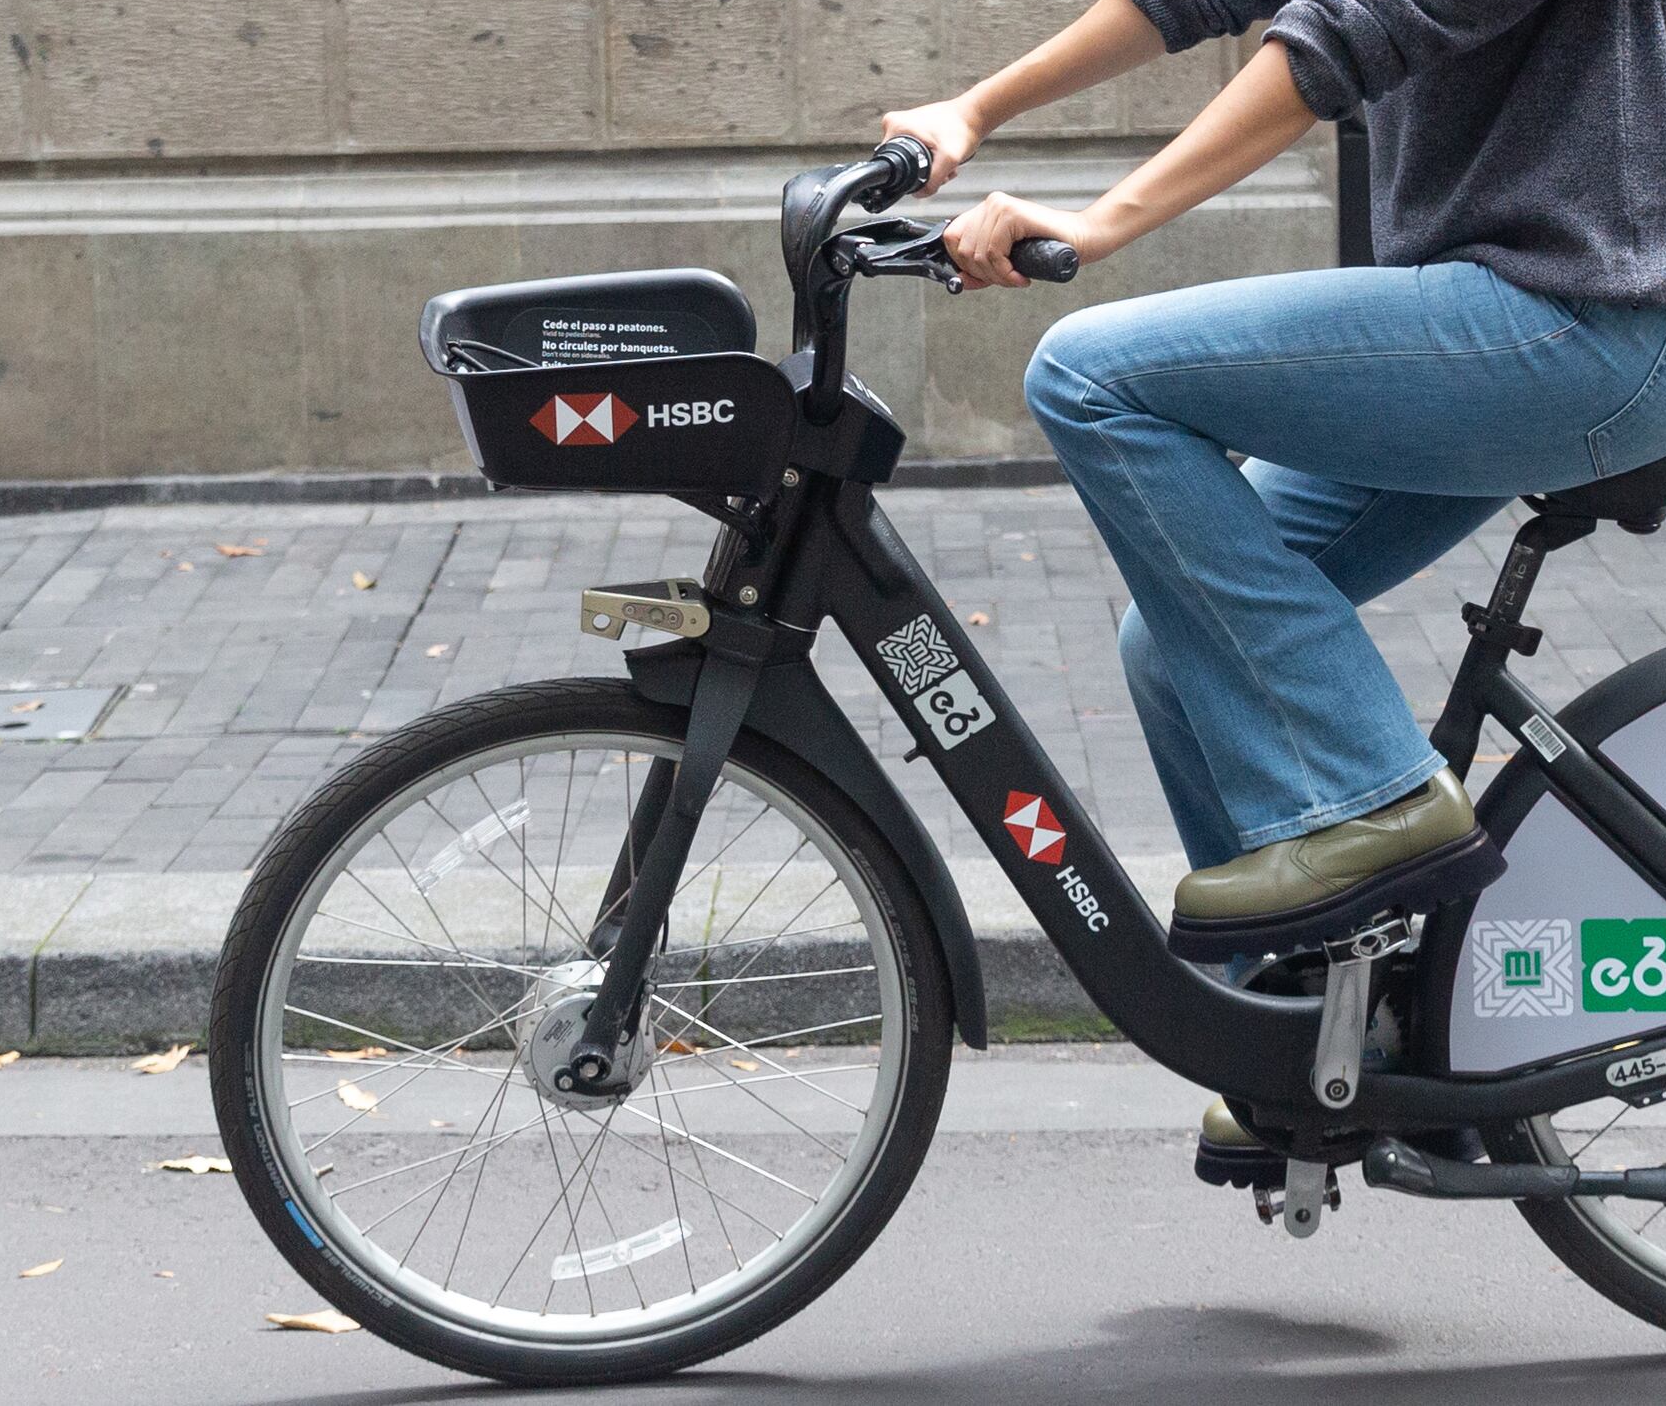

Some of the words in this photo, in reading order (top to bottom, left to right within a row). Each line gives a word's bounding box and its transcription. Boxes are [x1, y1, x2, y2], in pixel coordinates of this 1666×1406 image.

[543, 319, 569, 330] Cede
[570, 320, 581, 330] el
[582, 322, 607, 332] paso
[608, 323, 615, 331] a
[617, 323, 668, 334] peatones.
[542, 340, 557, 350] No
[558, 340, 599, 351] circules
[600, 343, 619, 354] por
[620, 342, 678, 355] banquetas.
[647, 398, 735, 428] HSBC
[1055, 864, 1110, 933] HSBC
